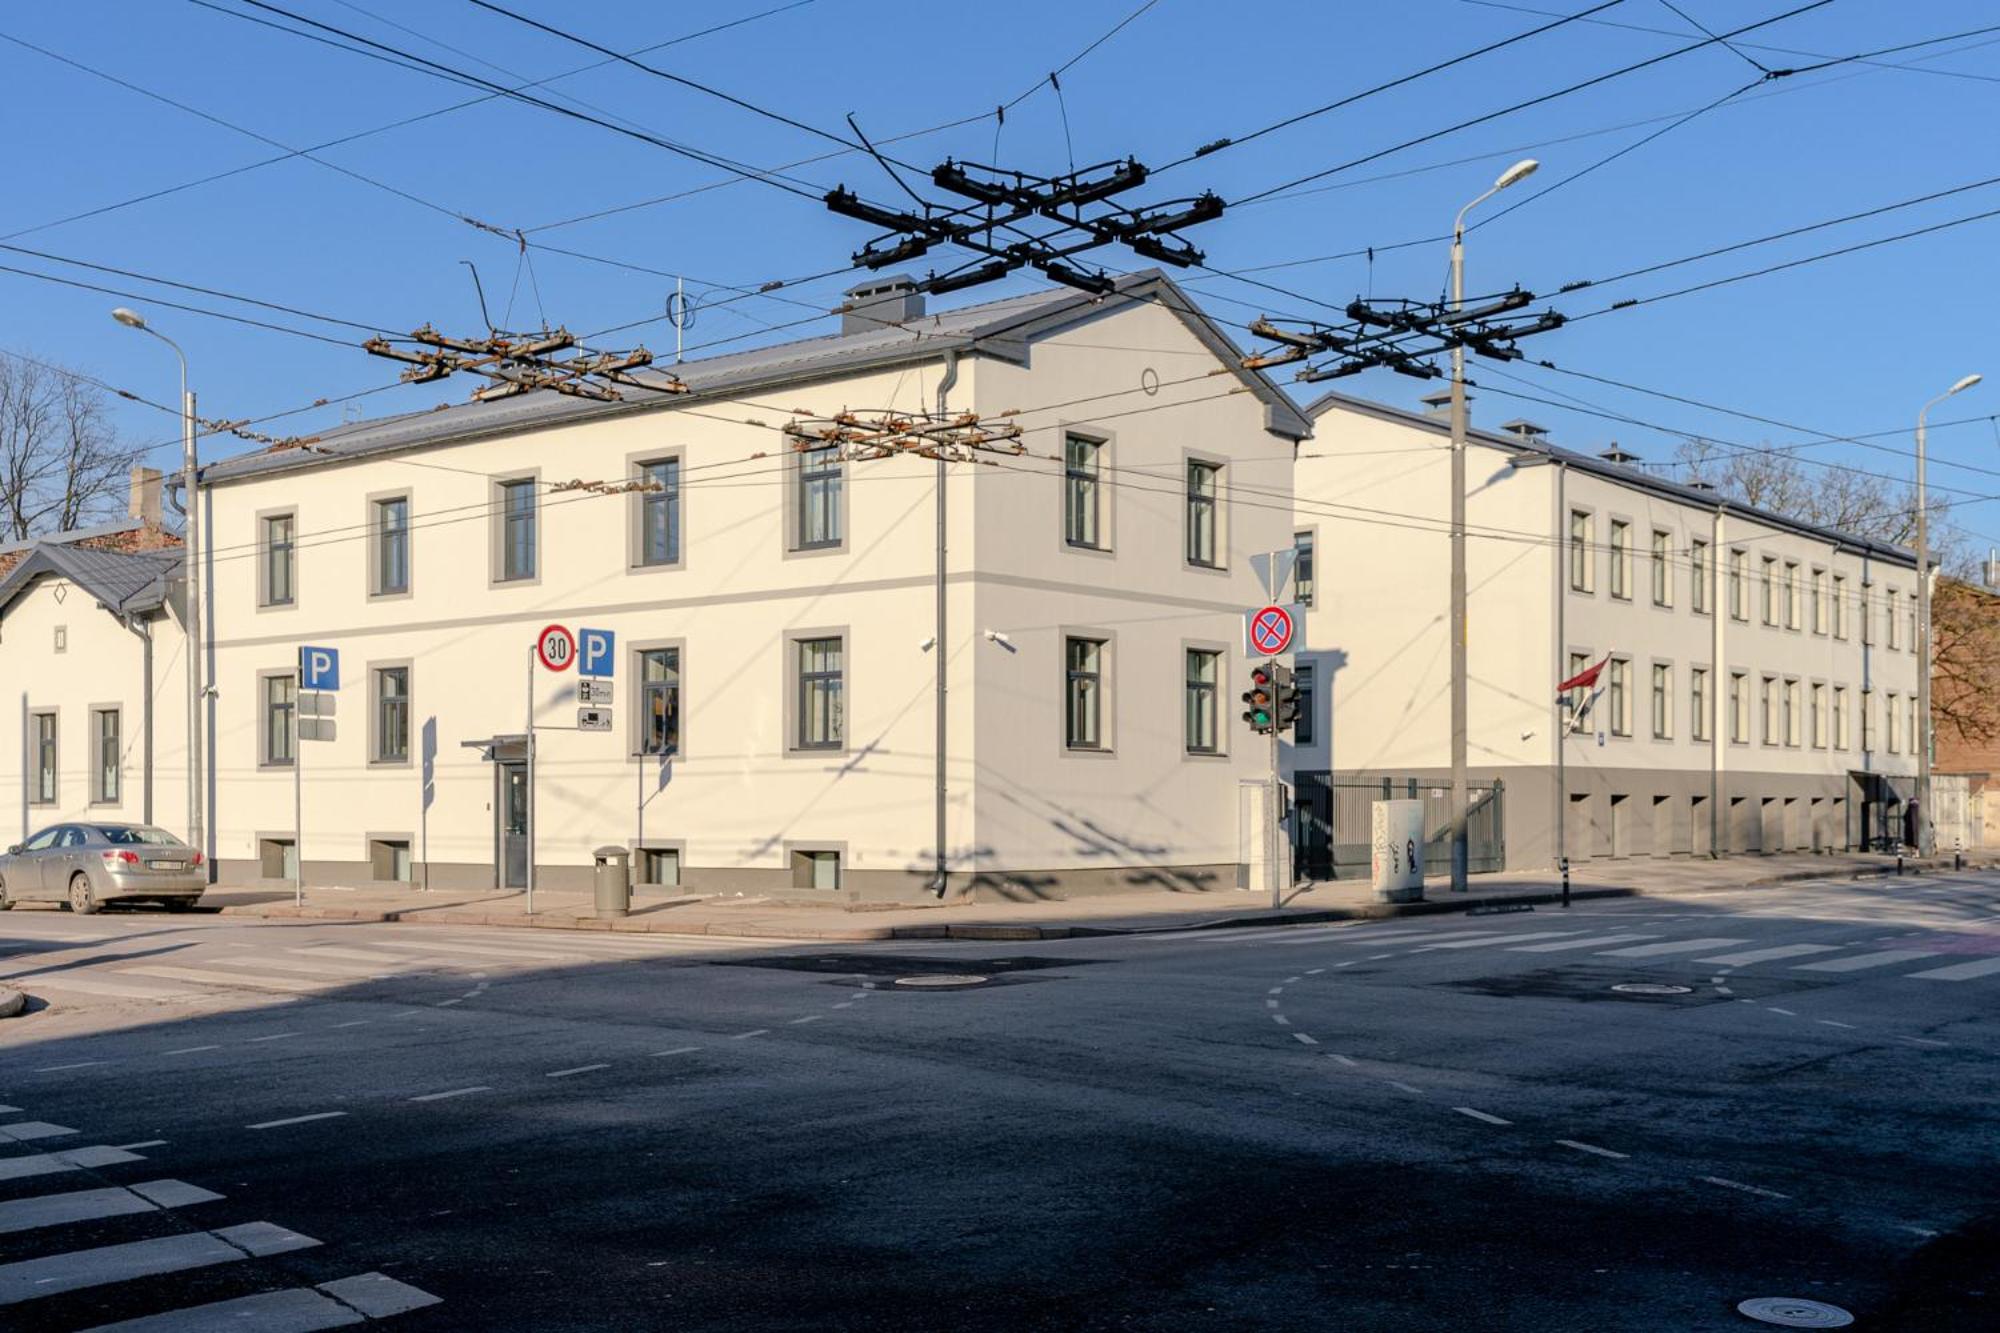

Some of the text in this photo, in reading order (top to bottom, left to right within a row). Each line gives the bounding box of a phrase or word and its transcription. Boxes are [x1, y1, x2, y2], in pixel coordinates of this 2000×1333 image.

[548, 637, 566, 660] 30
[587, 634, 607, 671] P
[311, 651, 331, 685] P
